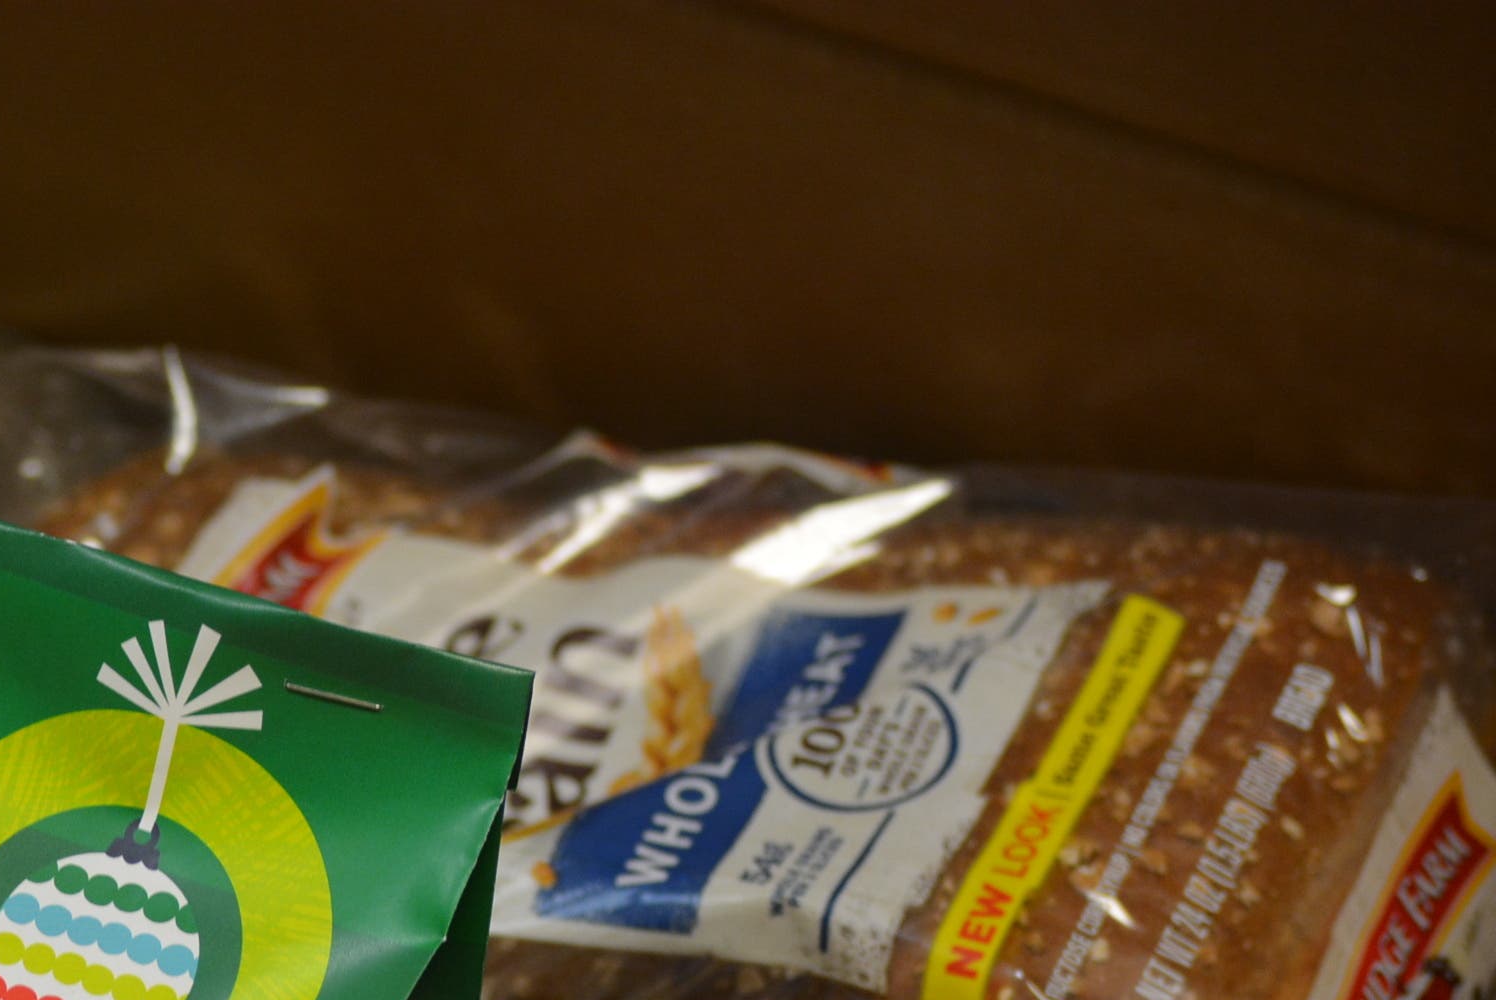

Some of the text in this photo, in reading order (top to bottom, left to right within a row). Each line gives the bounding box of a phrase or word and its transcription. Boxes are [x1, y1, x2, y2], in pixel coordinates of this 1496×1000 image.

[615, 742, 741, 888] WHOL
[946, 882, 1013, 981] NEW
[996, 803, 1057, 879] LOOK
[1184, 874, 1229, 914] OZ
[1397, 825, 1474, 930] FARM
[1155, 924, 1201, 968] WT
[1170, 901, 1214, 940] 24
